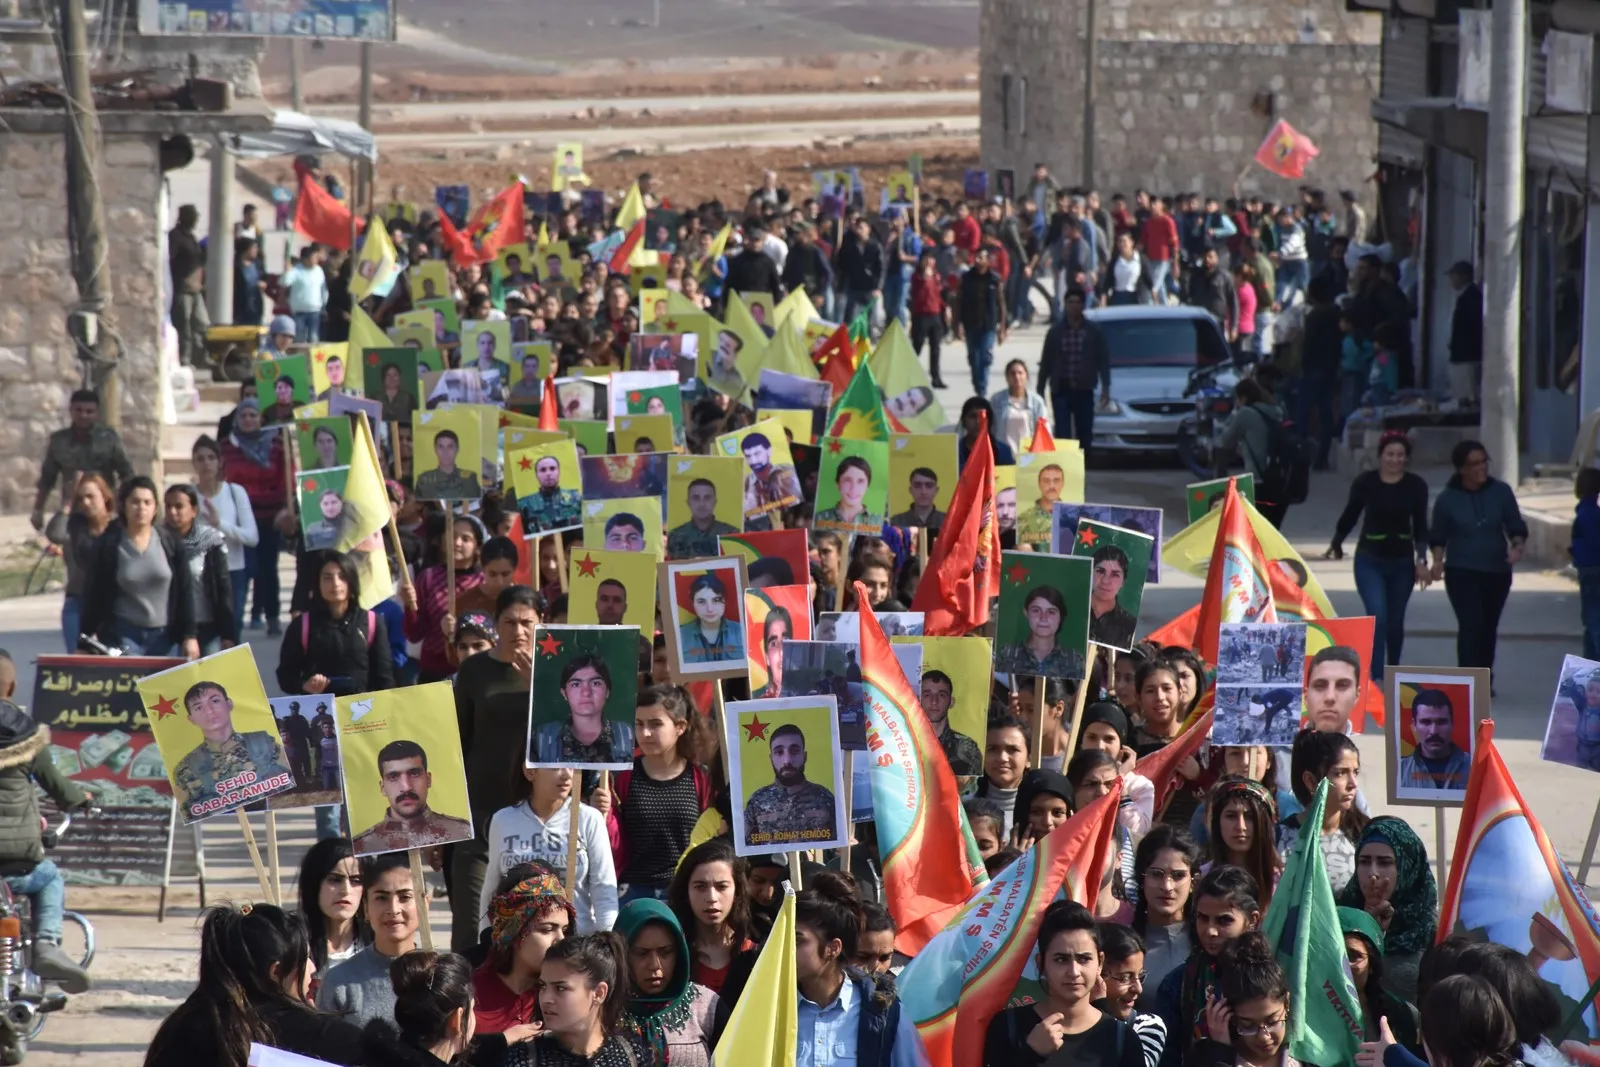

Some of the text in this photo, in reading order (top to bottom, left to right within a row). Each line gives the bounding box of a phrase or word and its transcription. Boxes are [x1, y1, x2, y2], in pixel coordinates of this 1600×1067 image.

[41, 670, 114, 698] وصرافة
[51, 703, 129, 729] مظلوم
[191, 791, 242, 816] GABAR
[242, 772, 290, 799] AMUDE
[988, 879, 1023, 940] MALBATÊN
